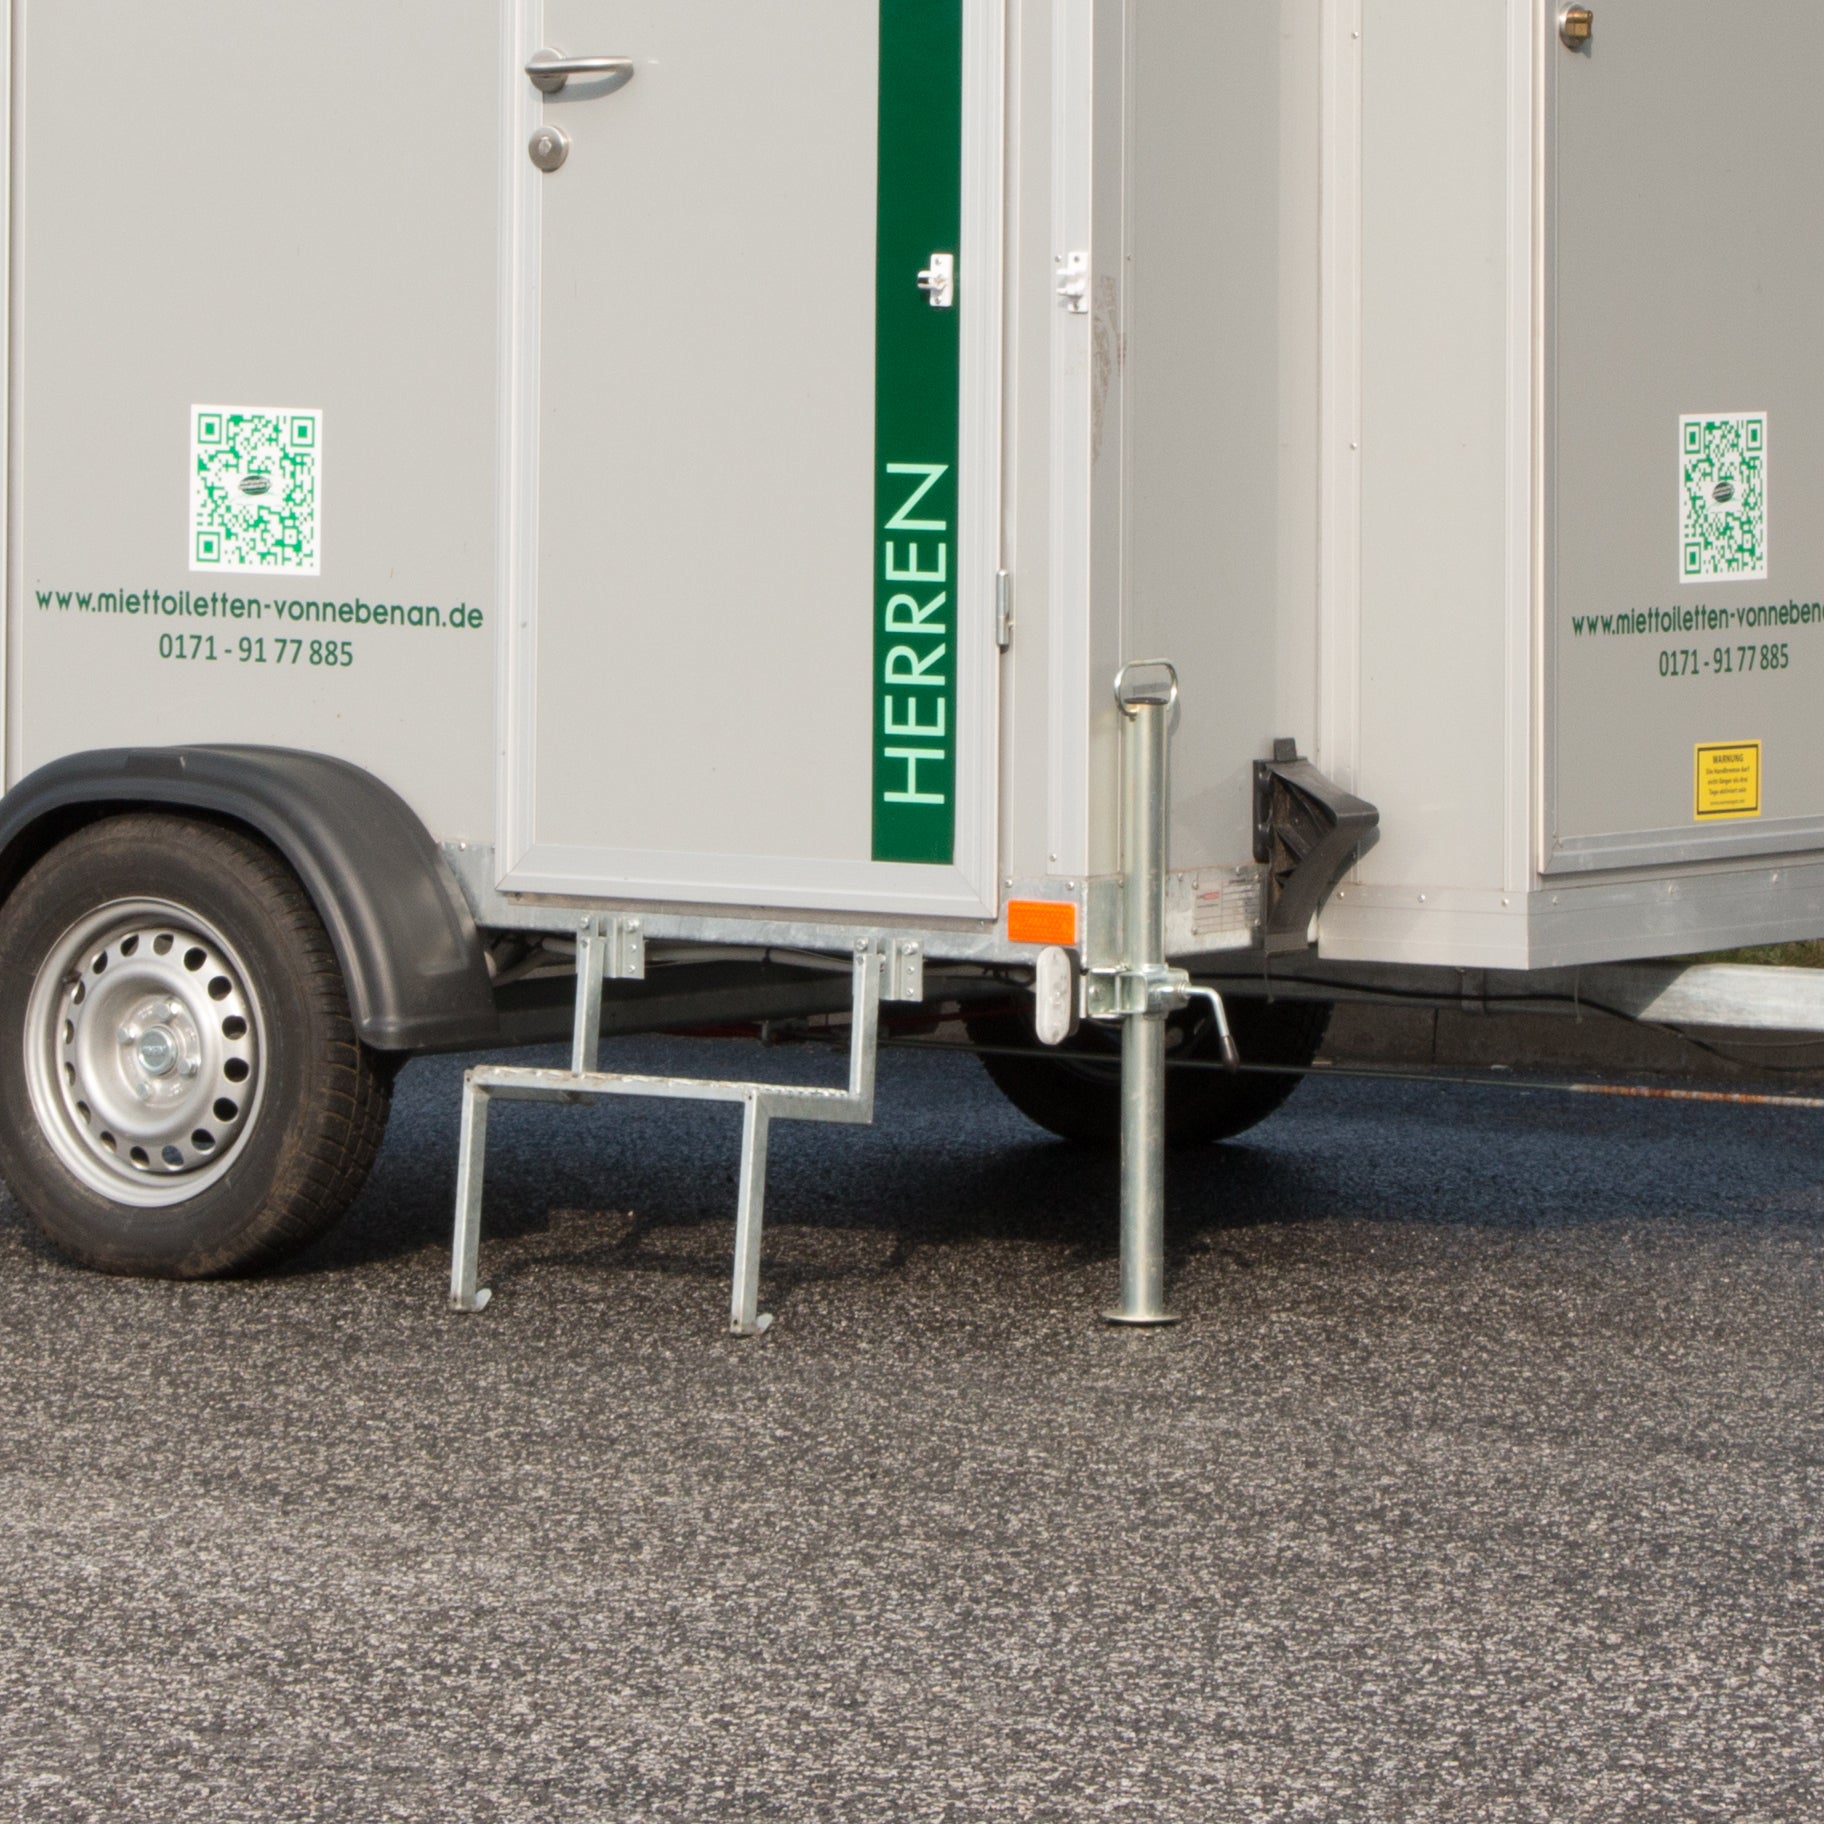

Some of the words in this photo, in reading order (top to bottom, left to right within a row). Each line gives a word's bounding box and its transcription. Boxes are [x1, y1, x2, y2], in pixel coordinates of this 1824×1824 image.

[36, 588, 484, 628] www.miettoiletten-vonnebenan.de
[159, 633, 217, 660] 0171
[309, 639, 353, 666] 885
[884, 462, 949, 805] HERREN
[1659, 648, 1700, 677] 0171
[1760, 642, 1789, 670] 885
